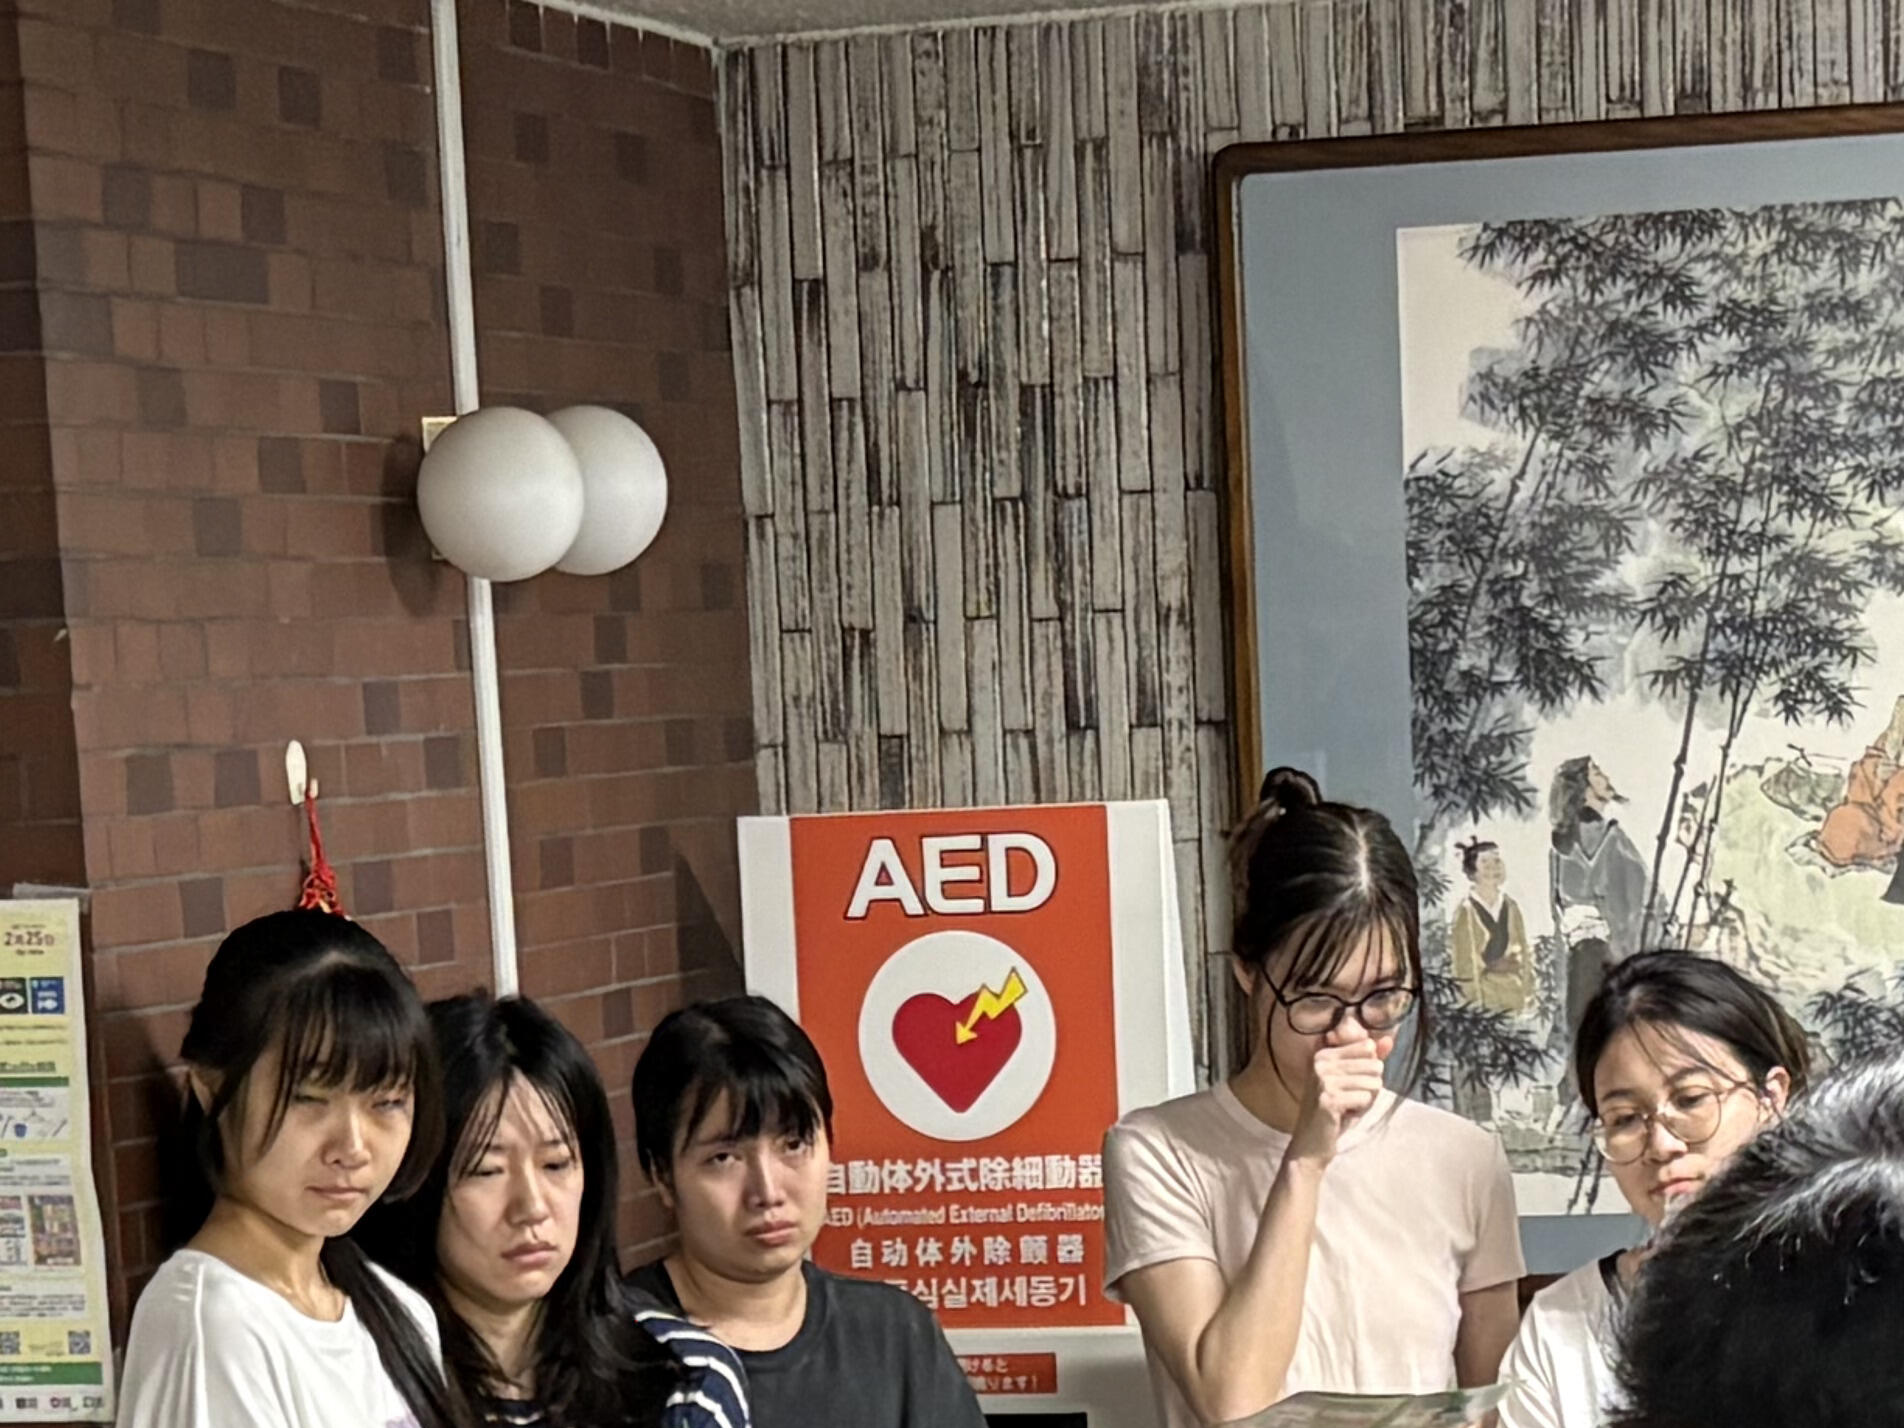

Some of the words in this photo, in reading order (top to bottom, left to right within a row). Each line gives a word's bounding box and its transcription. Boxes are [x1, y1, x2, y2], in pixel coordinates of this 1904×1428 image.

[844, 831, 1058, 919] AED
[827, 1154, 1103, 1194] 自動体外式除細動器
[949, 1203, 1013, 1223] External
[884, 1274, 1086, 1309] 심실제세동기
